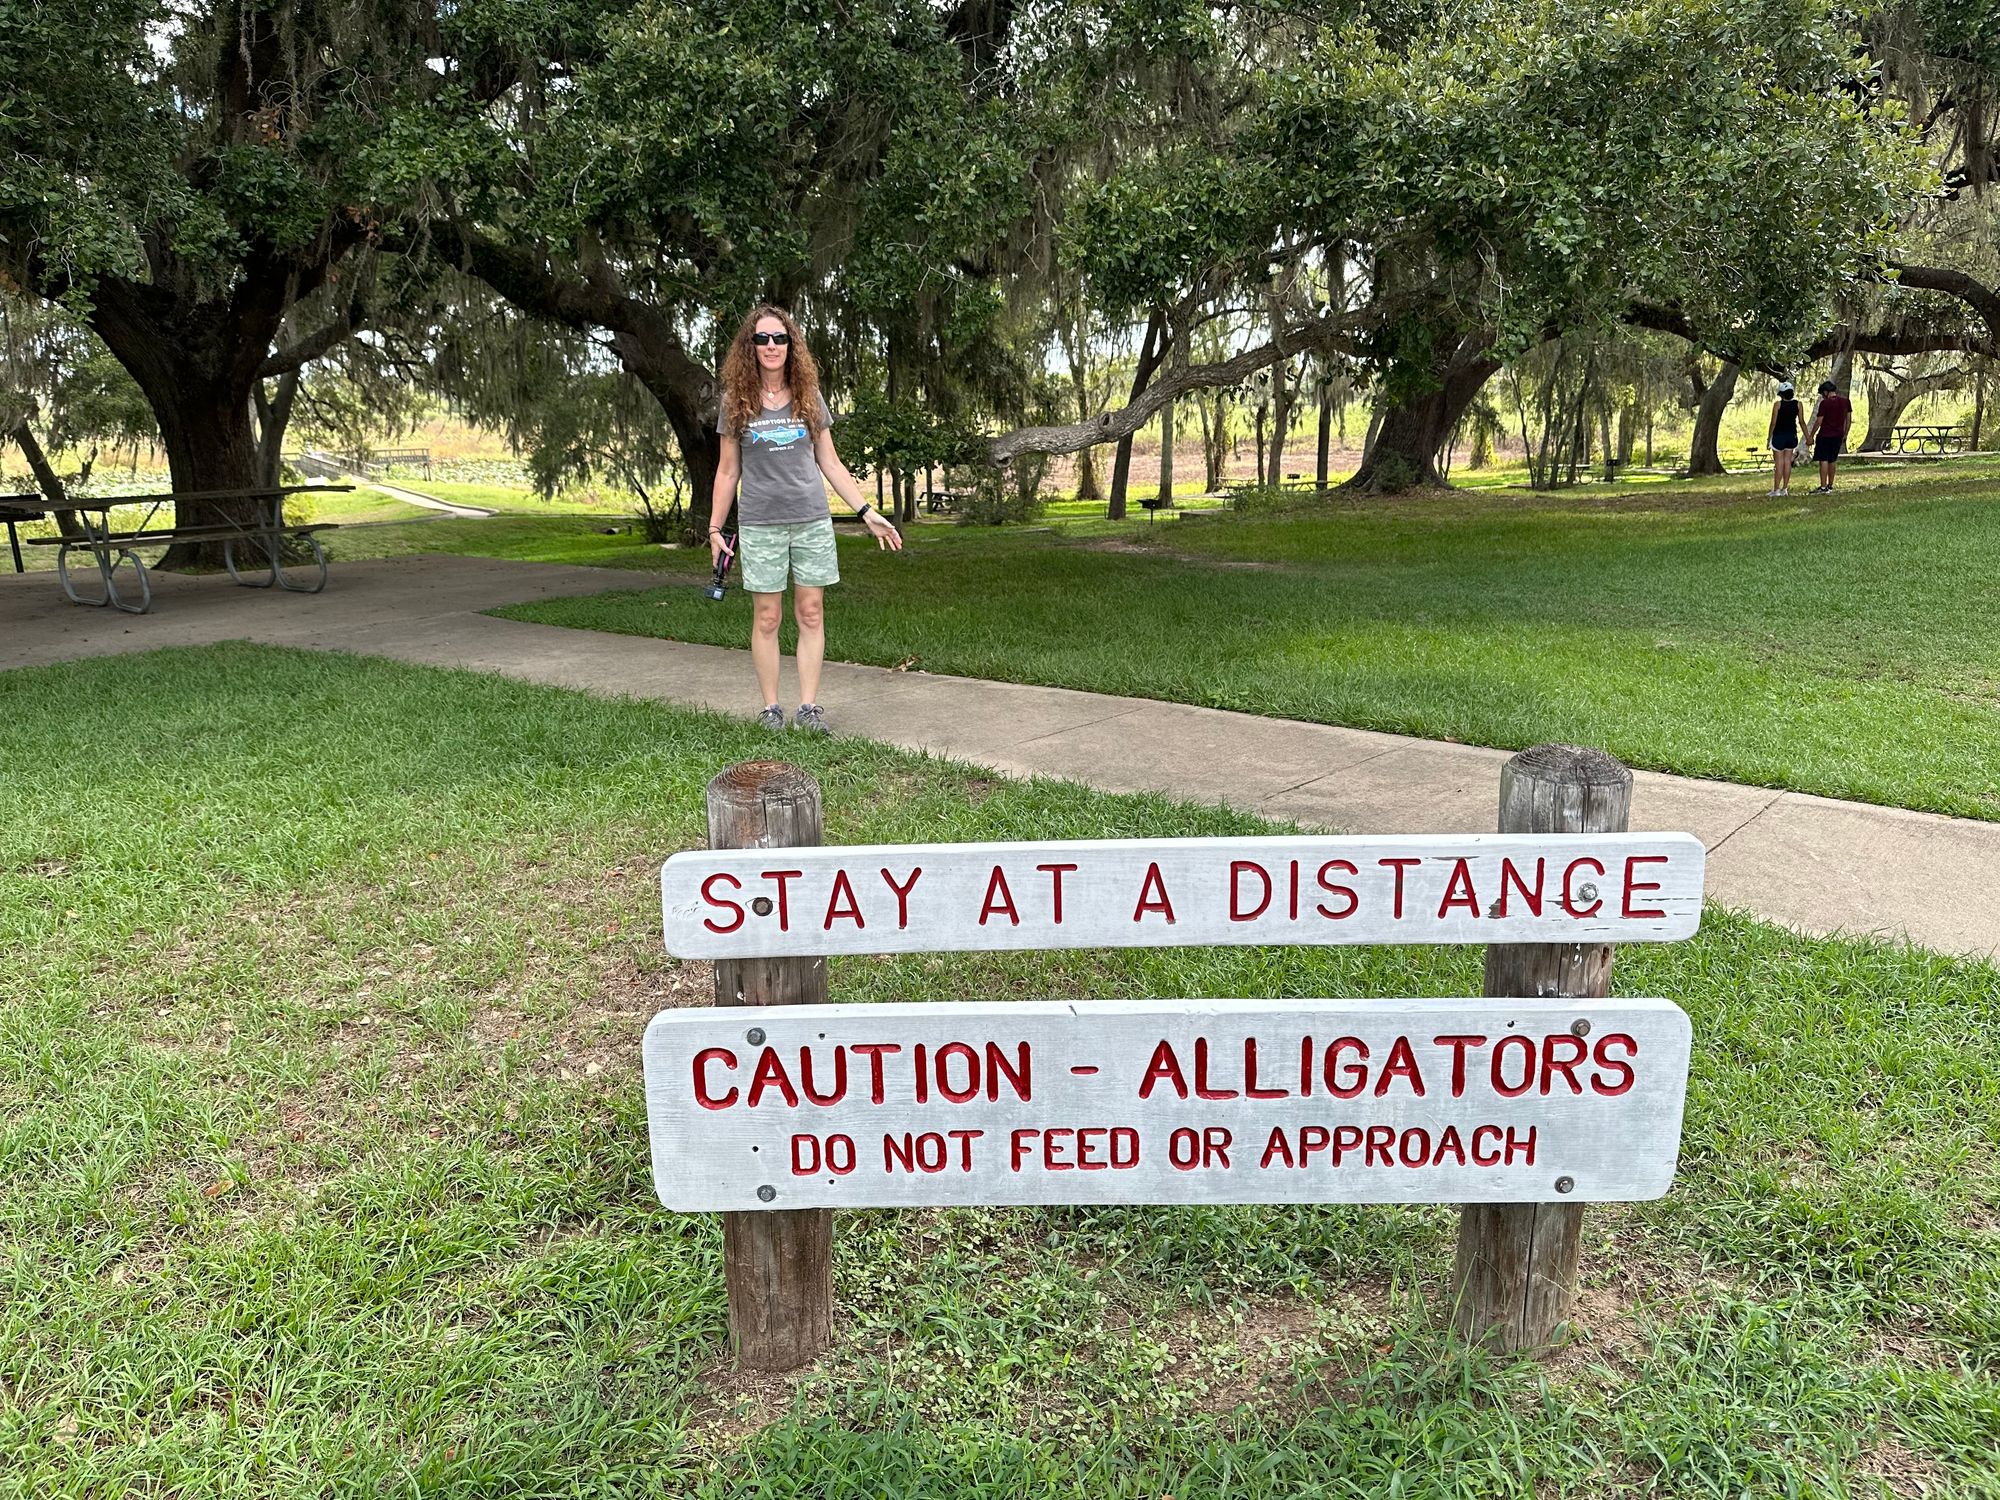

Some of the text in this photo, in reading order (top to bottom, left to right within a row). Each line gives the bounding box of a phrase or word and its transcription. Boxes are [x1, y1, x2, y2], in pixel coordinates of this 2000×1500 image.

[700, 855, 1669, 934] STAY AT A DISTANCE
[692, 1033, 1638, 1110] CAUTION - ALLIGATORS
[790, 1125, 1537, 1176] DO NOT FEED OR APPROACH
